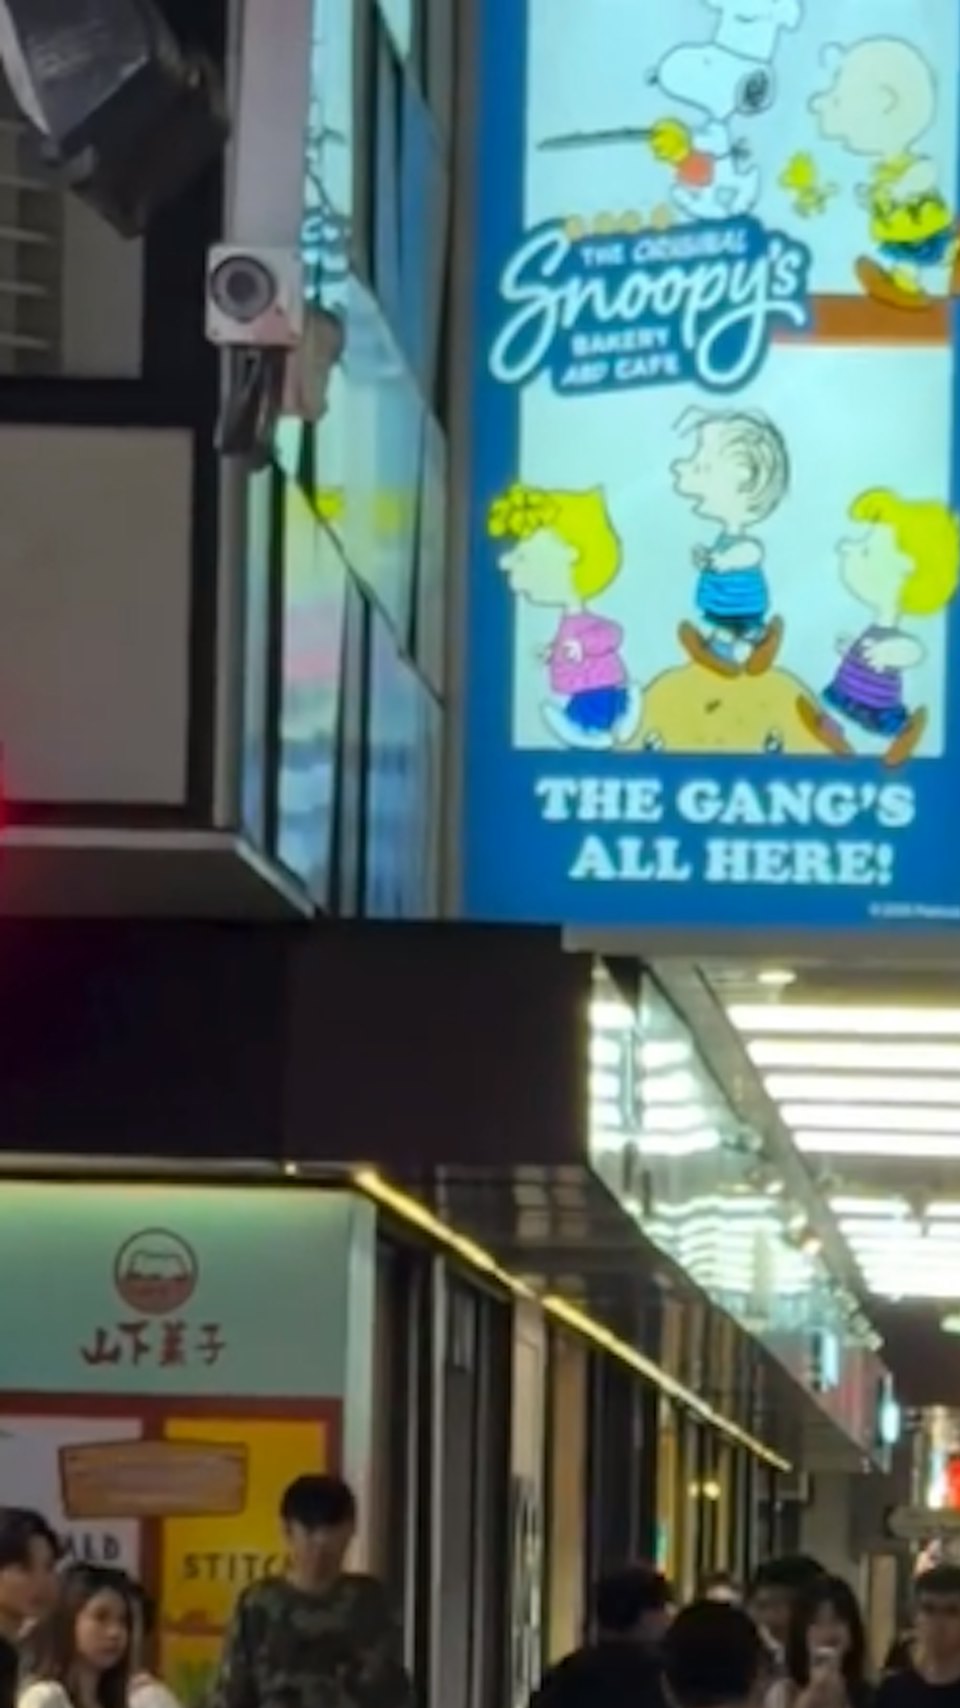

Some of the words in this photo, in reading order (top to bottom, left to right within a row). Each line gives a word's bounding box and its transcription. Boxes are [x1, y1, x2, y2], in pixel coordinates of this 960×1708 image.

[580, 243, 625, 267] THE
[490, 226, 806, 384] Snoopy's
[571, 328, 670, 357] BAKERY
[535, 777, 663, 822] THE
[675, 780, 916, 827] GANG'S
[567, 836, 691, 881] ALL
[703, 840, 894, 886] HERE!
